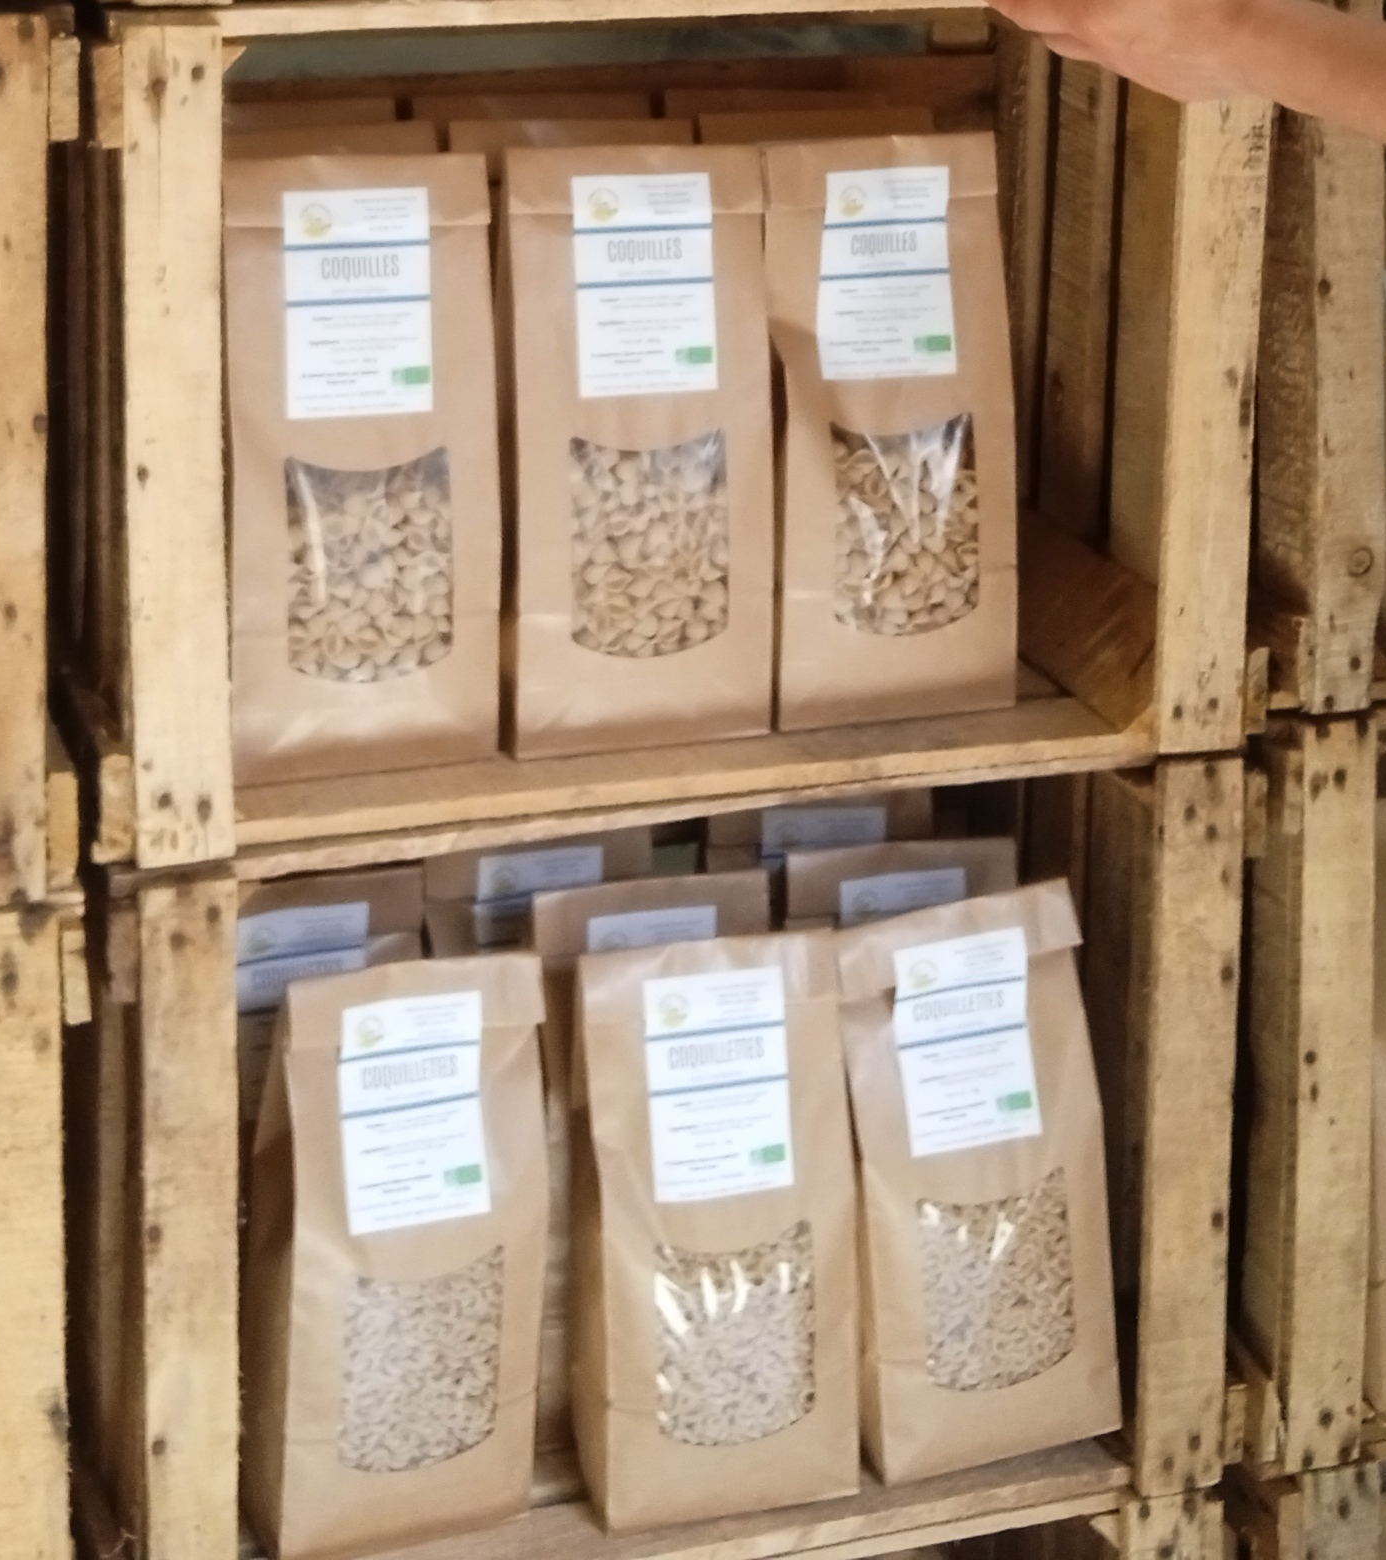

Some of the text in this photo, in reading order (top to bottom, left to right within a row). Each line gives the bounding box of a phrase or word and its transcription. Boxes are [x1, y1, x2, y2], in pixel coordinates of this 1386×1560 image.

[607, 238, 683, 264] COQUILLES
[850, 230, 918, 257] COQUILLES
[321, 254, 400, 282] COQUILLES
